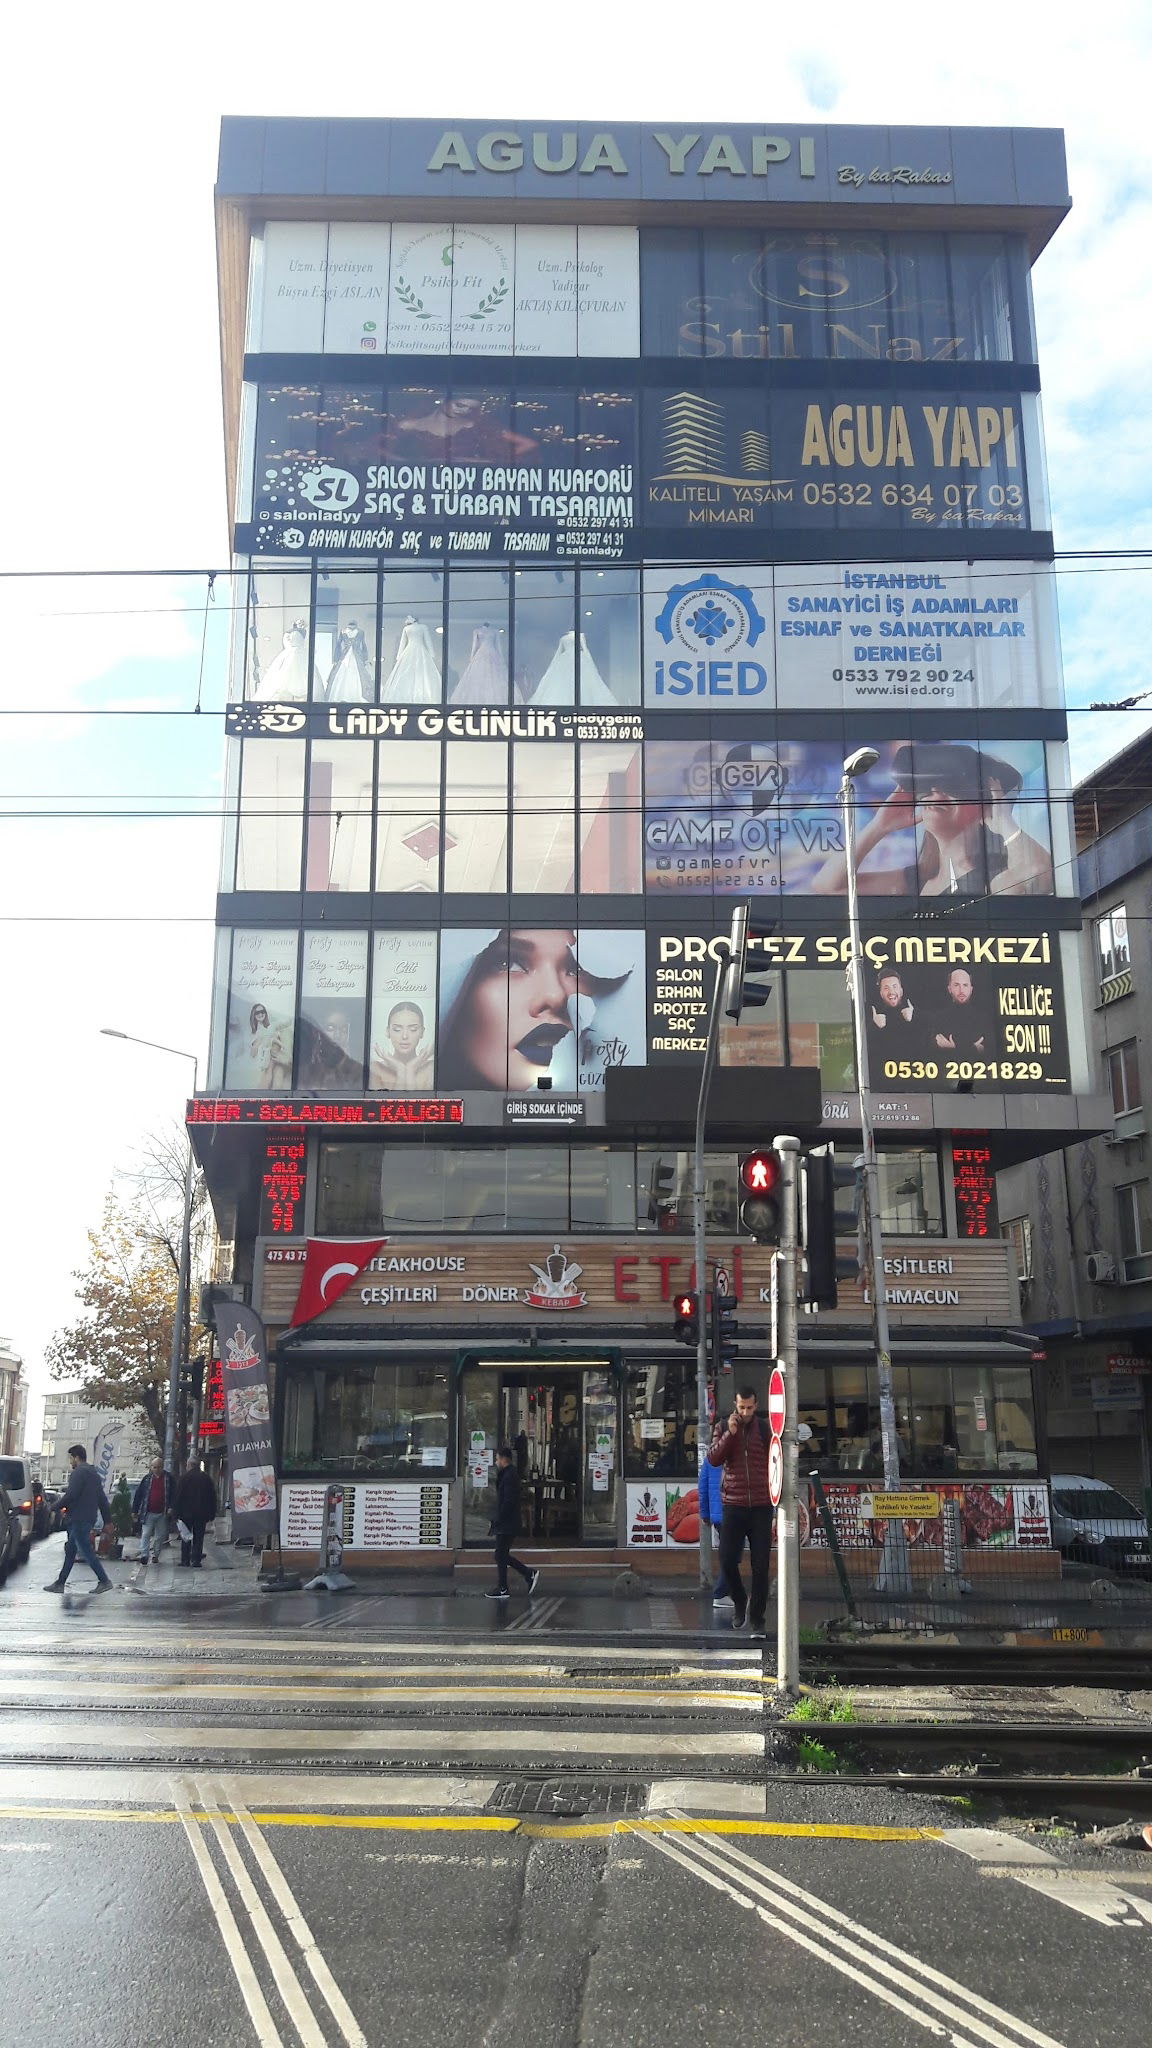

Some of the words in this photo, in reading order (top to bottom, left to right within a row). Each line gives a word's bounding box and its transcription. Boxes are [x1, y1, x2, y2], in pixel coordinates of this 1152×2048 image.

[426, 131, 629, 176] AGUA
[653, 133, 816, 178] YAPI
[837, 165, 865, 188] By
[289, 260, 317, 274] Uzm.
[537, 260, 562, 273] Uzm.
[422, 275, 458, 288] Psiko
[463, 276, 483, 288] Fit
[552, 279, 590, 295] Yadigar
[339, 286, 384, 299] ASLAN
[516, 299, 552, 314] AKTAŞ
[421, 322, 450, 333] 0552
[454, 322, 476, 333] 294
[480, 323, 493, 333] 15
[497, 323, 512, 333] 70
[678, 320, 797, 360] Stil
[824, 322, 967, 362] Naz
[801, 403, 915, 468] AGUA
[922, 405, 1017, 468] YAPI
[366, 465, 425, 490] SALON
[432, 466, 475, 491] LADY
[482, 469, 541, 493] BAYAN
[548, 464, 633, 493] KUAFORÜ
[314, 476, 349, 503] SL
[649, 483, 720, 502] KALİTELİ
[732, 486, 793, 507] YAŞAM
[803, 483, 872, 506] 0532
[881, 483, 934, 506] 634
[943, 484, 978, 506] 07
[988, 485, 1023, 507] 03
[364, 492, 405, 520] SAÇ
[412, 494, 427, 515] &
[434, 490, 521, 516] TÜRBAN
[529, 495, 633, 518] TASARIMI
[273, 509, 362, 524] salonladyy
[566, 517, 589, 528] 0532
[591, 517, 607, 528] 297
[609, 518, 620, 528] 41
[623, 518, 634, 528] 31
[910, 507, 936, 523] By
[308, 530, 349, 548] BAYAN
[349, 528, 394, 549] KUAFÖR
[400, 531, 422, 554] SAÇ
[429, 535, 443, 549] ve
[448, 530, 491, 551] TÜRBAN
[504, 532, 550, 552] TASARIM
[566, 531, 585, 545] 0532
[587, 532, 601, 545] 297
[603, 532, 612, 545] 41
[615, 532, 624, 545] 31
[566, 545, 623, 557] salonladyy
[844, 570, 946, 590] İSTANBUL
[788, 594, 882, 614] SANAYİCİ
[886, 594, 904, 617] İŞ
[912, 597, 1018, 615] ADAMLARI
[780, 620, 841, 637] ESNAF
[849, 623, 872, 637] ve
[879, 620, 1026, 638] SANATKARLAR
[853, 644, 942, 662] DERNEĞİ
[832, 668, 879, 683] 0533
[886, 668, 921, 683] 792
[926, 668, 949, 683] 90
[952, 668, 975, 683] 24
[855, 684, 955, 698] www.isied.org
[328, 708, 408, 735] LADY
[418, 707, 557, 738] GELİNLİK
[577, 726, 599, 739] 0533
[600, 726, 617, 739] 330
[619, 727, 631, 739] 69
[632, 727, 644, 739] 06
[647, 818, 734, 852] GAME
[741, 818, 786, 855] OF
[792, 818, 845, 853] VR
[677, 855, 770, 870] gameofvr
[748, 876, 766, 887] 85
[895, 932, 1051, 964] MERKEZİ
[656, 969, 703, 982] SALON
[657, 986, 703, 999] ERHAN
[1000, 984, 1054, 1017] KELLİĞE
[653, 1002, 708, 1016] PROTEZ
[668, 1018, 696, 1034] SAÇ
[652, 1036, 709, 1051] MERKEZİ
[1006, 1025, 1034, 1053] SON
[1039, 1024, 1052, 1054] !!!
[884, 1061, 938, 1079] 0530
[946, 1062, 1043, 1080] 2021829
[259, 1104, 363, 1122] SOLARIUM
[380, 1104, 446, 1122] KALICI
[506, 1102, 528, 1117] GİRİŞ
[528, 1103, 556, 1115] SOKAK
[556, 1102, 583, 1117] İÇİNDE
[879, 1103, 901, 1111] KAT:
[903, 1103, 909, 1111] 1
[266, 1143, 305, 1160] ETÇİ
[263, 1174, 306, 1186] PAKET
[267, 1186, 301, 1200] 475
[271, 1218, 294, 1233] 75
[267, 1250, 283, 1261] 475
[284, 1251, 296, 1261] 43
[297, 1251, 308, 1261] 75
[363, 1256, 466, 1273] TEAKHOUSE
[881, 1256, 953, 1276] EŞİTLERİ
[614, 1246, 744, 1306] ETİ
[361, 1284, 438, 1305] ÇEŞİTLERİ
[462, 1284, 519, 1302] DÖNER
[864, 1289, 960, 1305] LHMACUN
[542, 1298, 570, 1307] KEBAP
